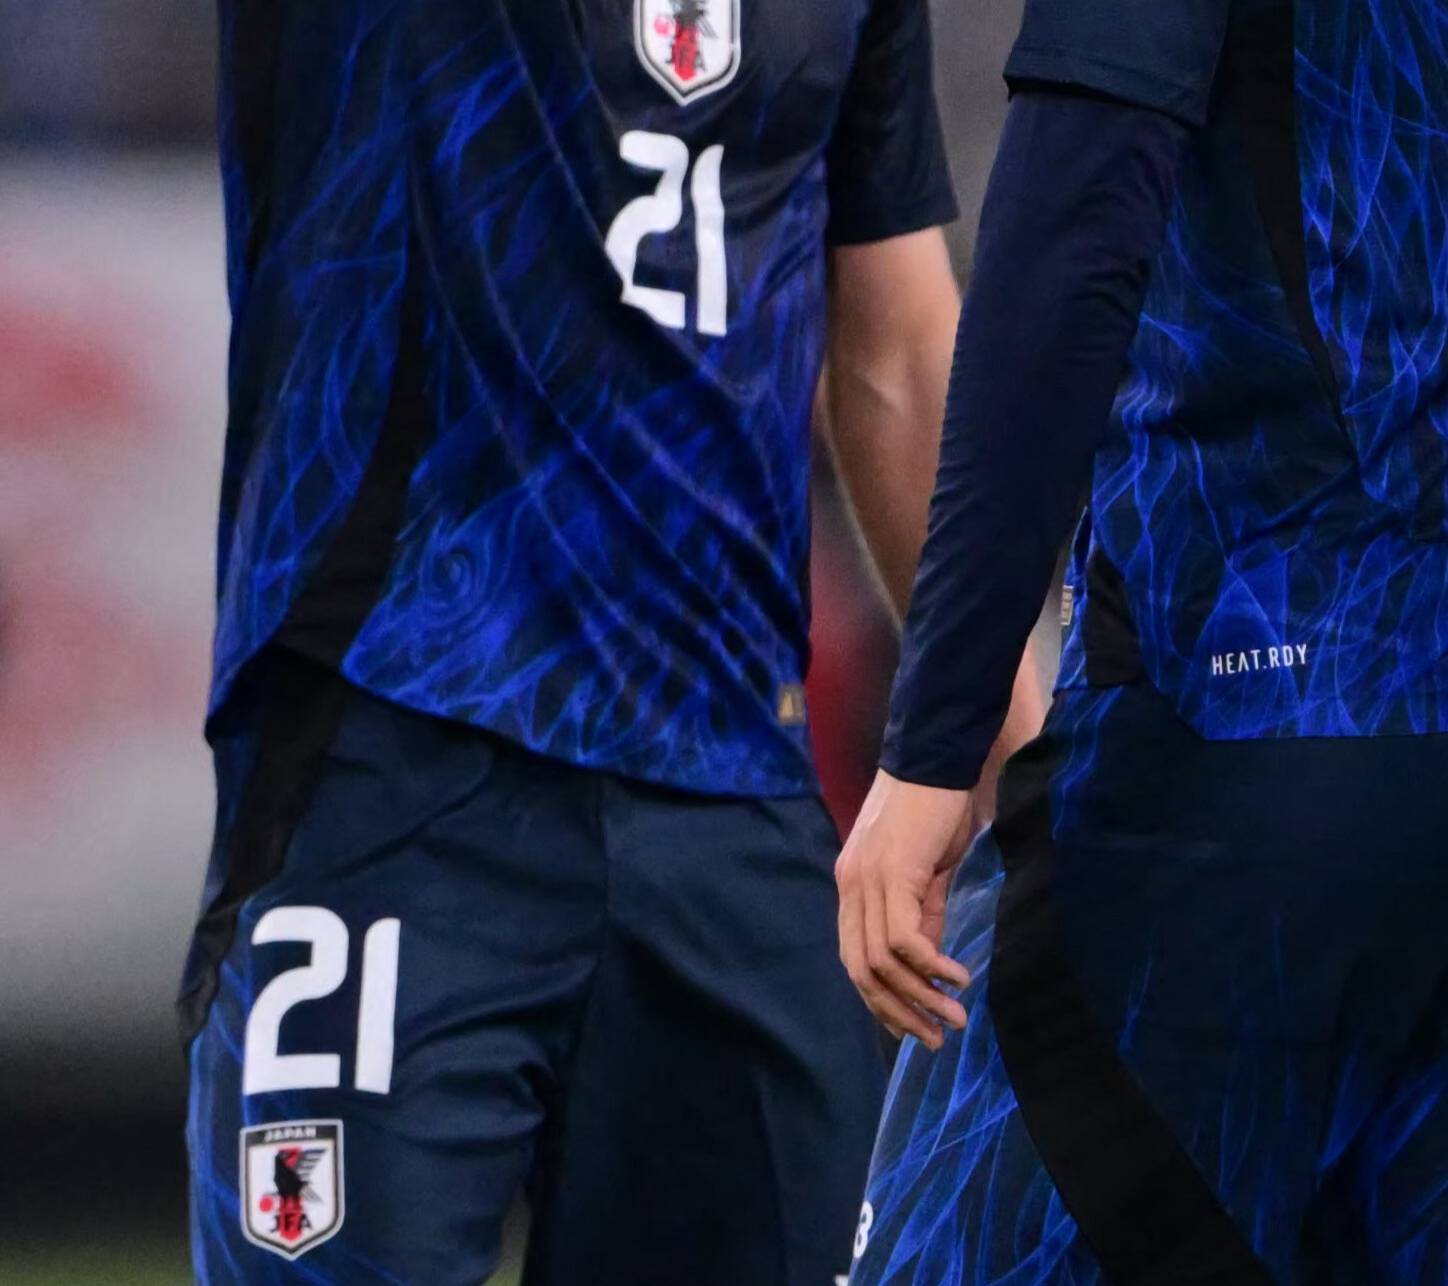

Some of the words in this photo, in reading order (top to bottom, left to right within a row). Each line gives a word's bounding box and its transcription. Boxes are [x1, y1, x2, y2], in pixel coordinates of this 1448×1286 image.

[605, 130, 728, 336] 21
[1211, 643, 1308, 676] HEAT.RDY
[242, 905, 401, 1095] 21
[264, 1126, 317, 1142] JAPAN
[268, 1212, 313, 1233] JFA
